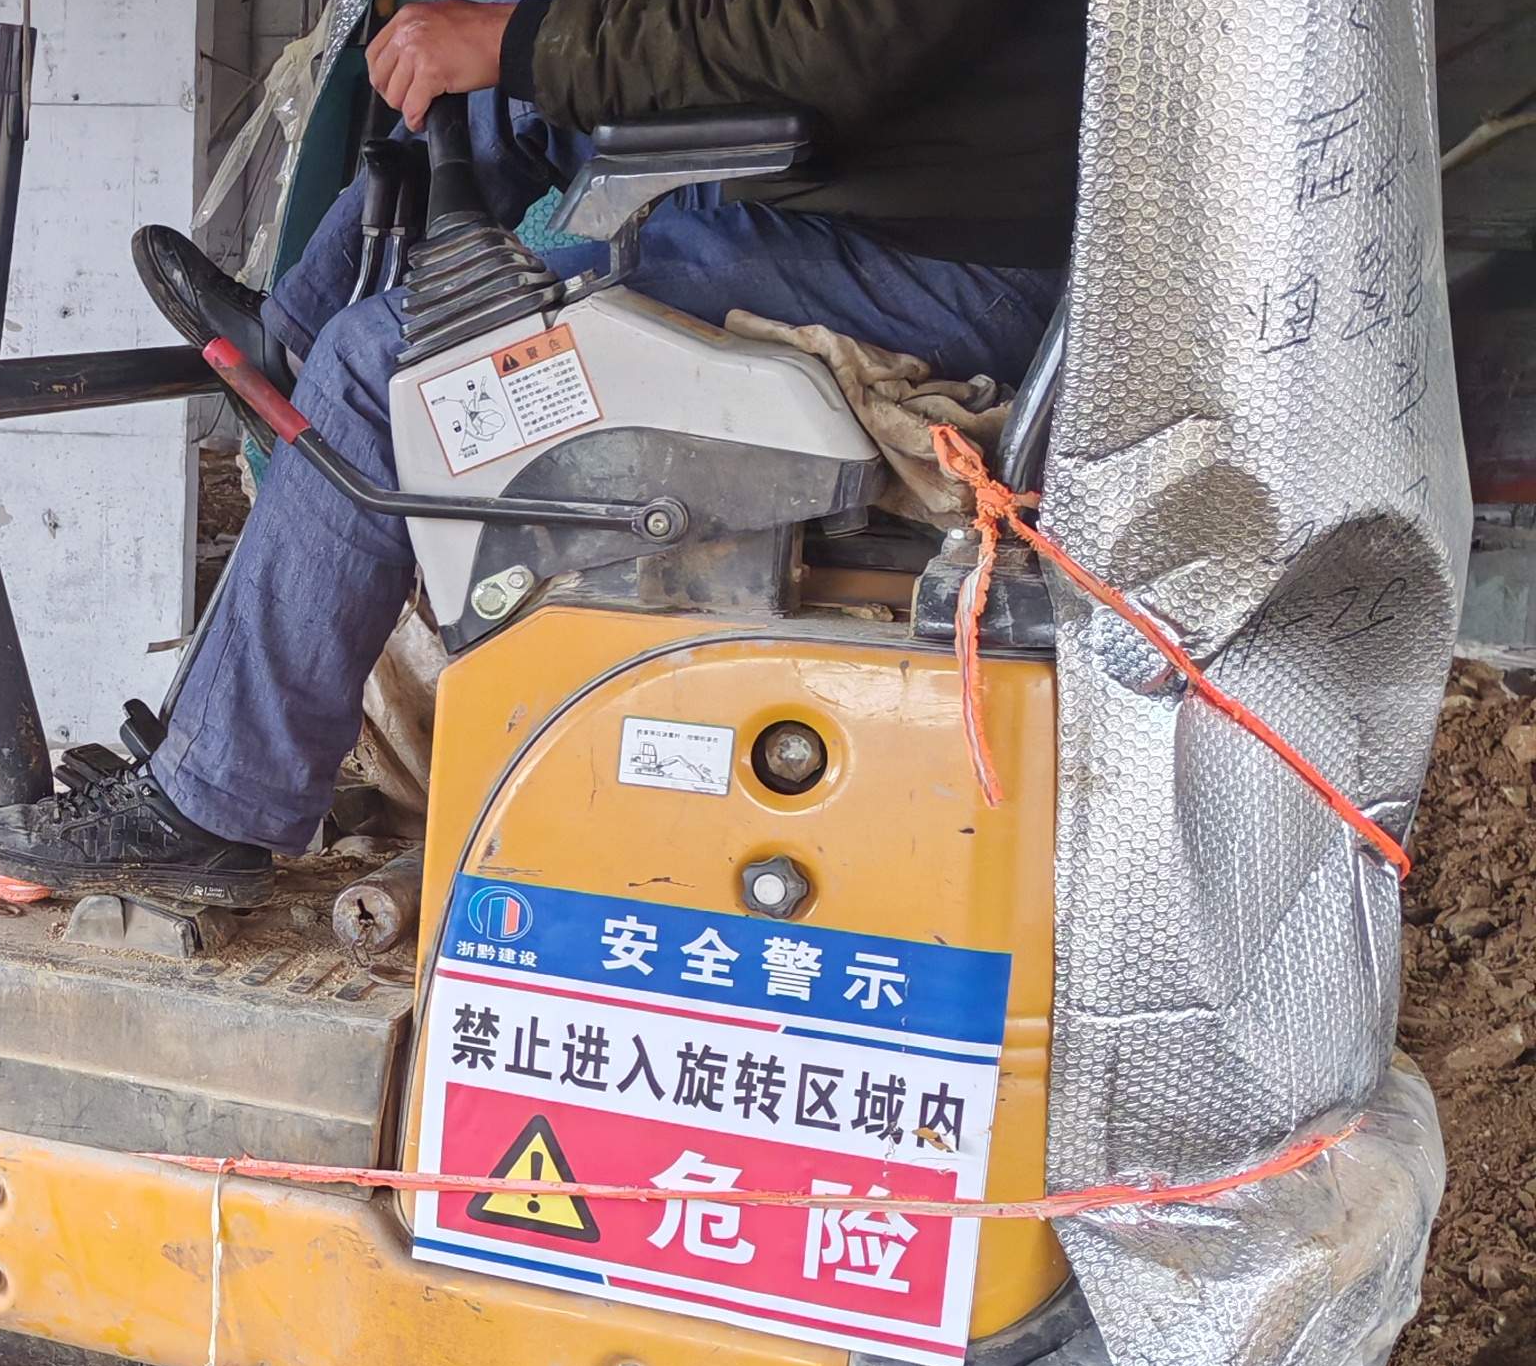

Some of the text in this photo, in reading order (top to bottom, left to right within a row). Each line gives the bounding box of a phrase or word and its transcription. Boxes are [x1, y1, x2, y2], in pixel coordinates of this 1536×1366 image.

[456, 940, 538, 968] 浙黔建设
[600, 915, 906, 1010] 安全警示
[451, 1003, 965, 1152] 禁止进入旋转区域内
[647, 1149, 920, 1294] 危险
